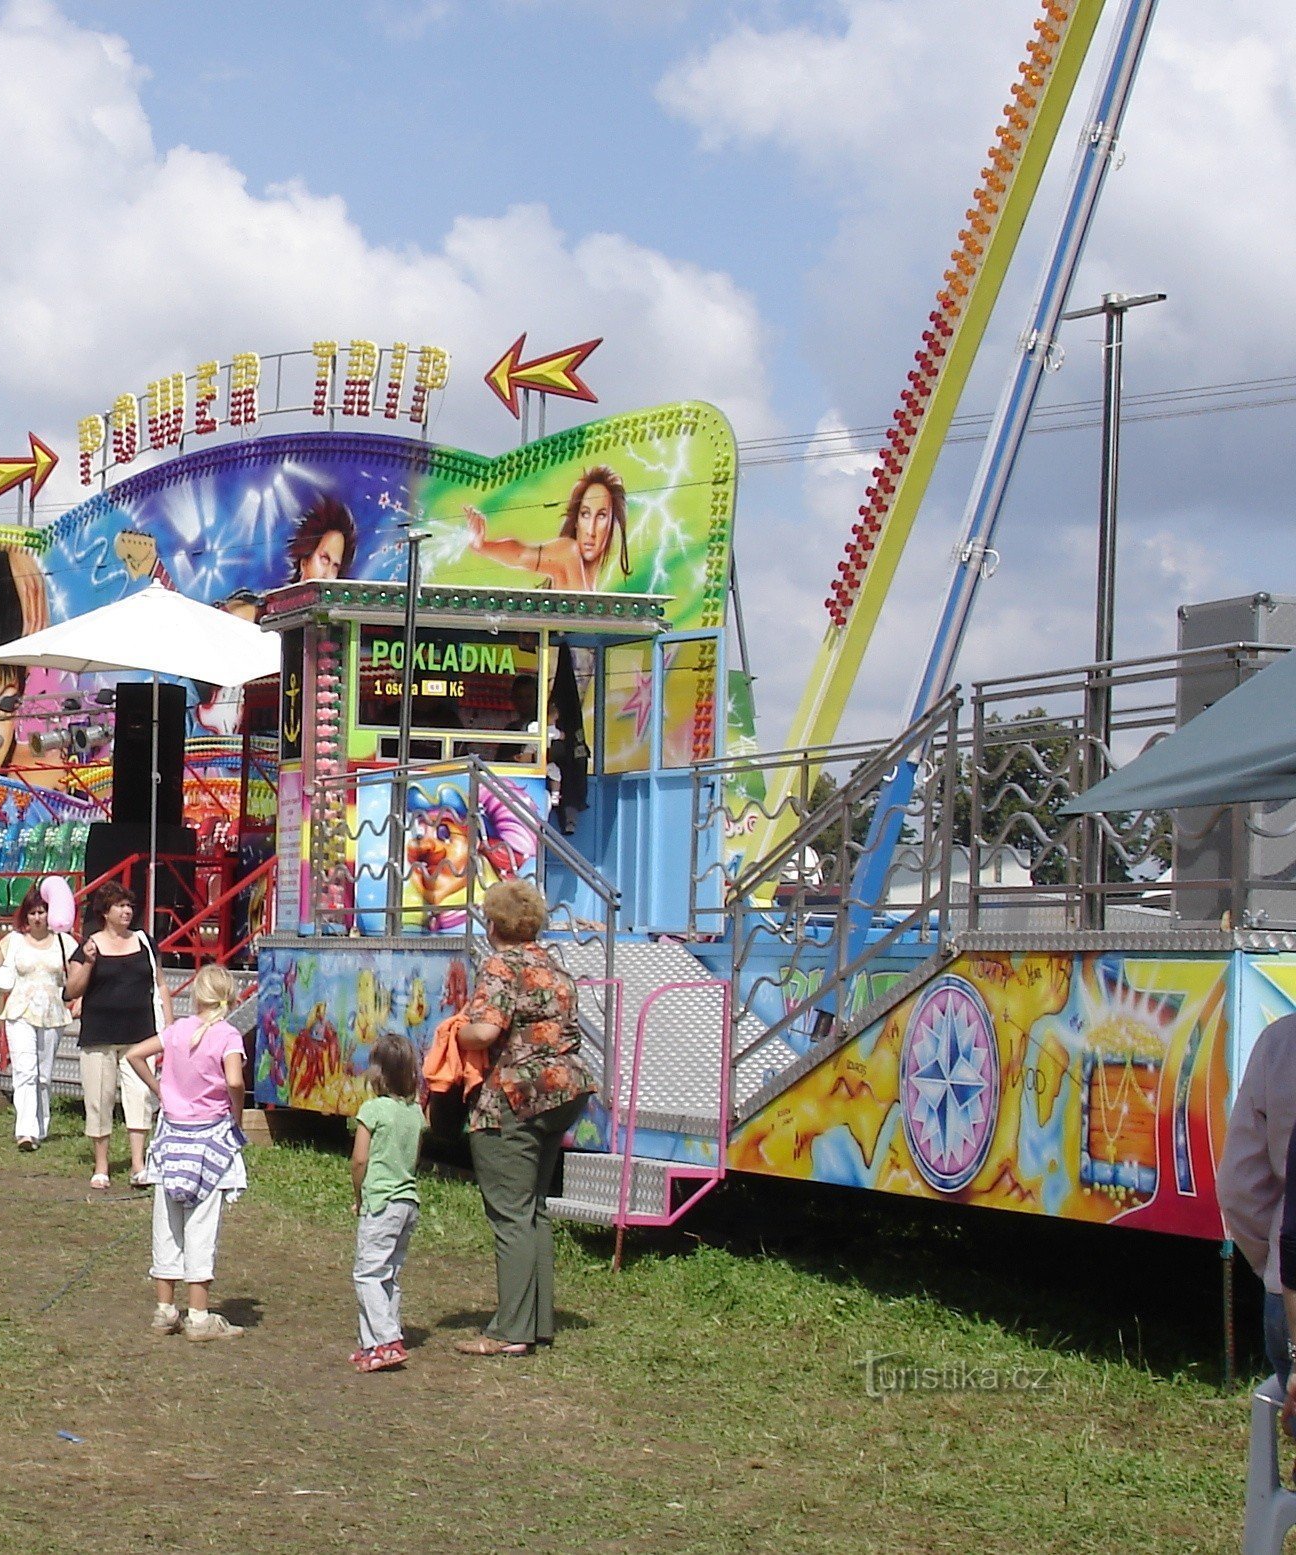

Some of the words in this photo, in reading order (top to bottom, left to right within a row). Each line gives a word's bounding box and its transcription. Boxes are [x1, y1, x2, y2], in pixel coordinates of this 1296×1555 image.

[77, 351, 261, 486] POWER
[312, 340, 450, 423] TRIP
[372, 639, 516, 676] POKLADNA
[374, 679, 382, 695] 1
[385, 681, 418, 696] osoa
[449, 680, 464, 697] Kč
